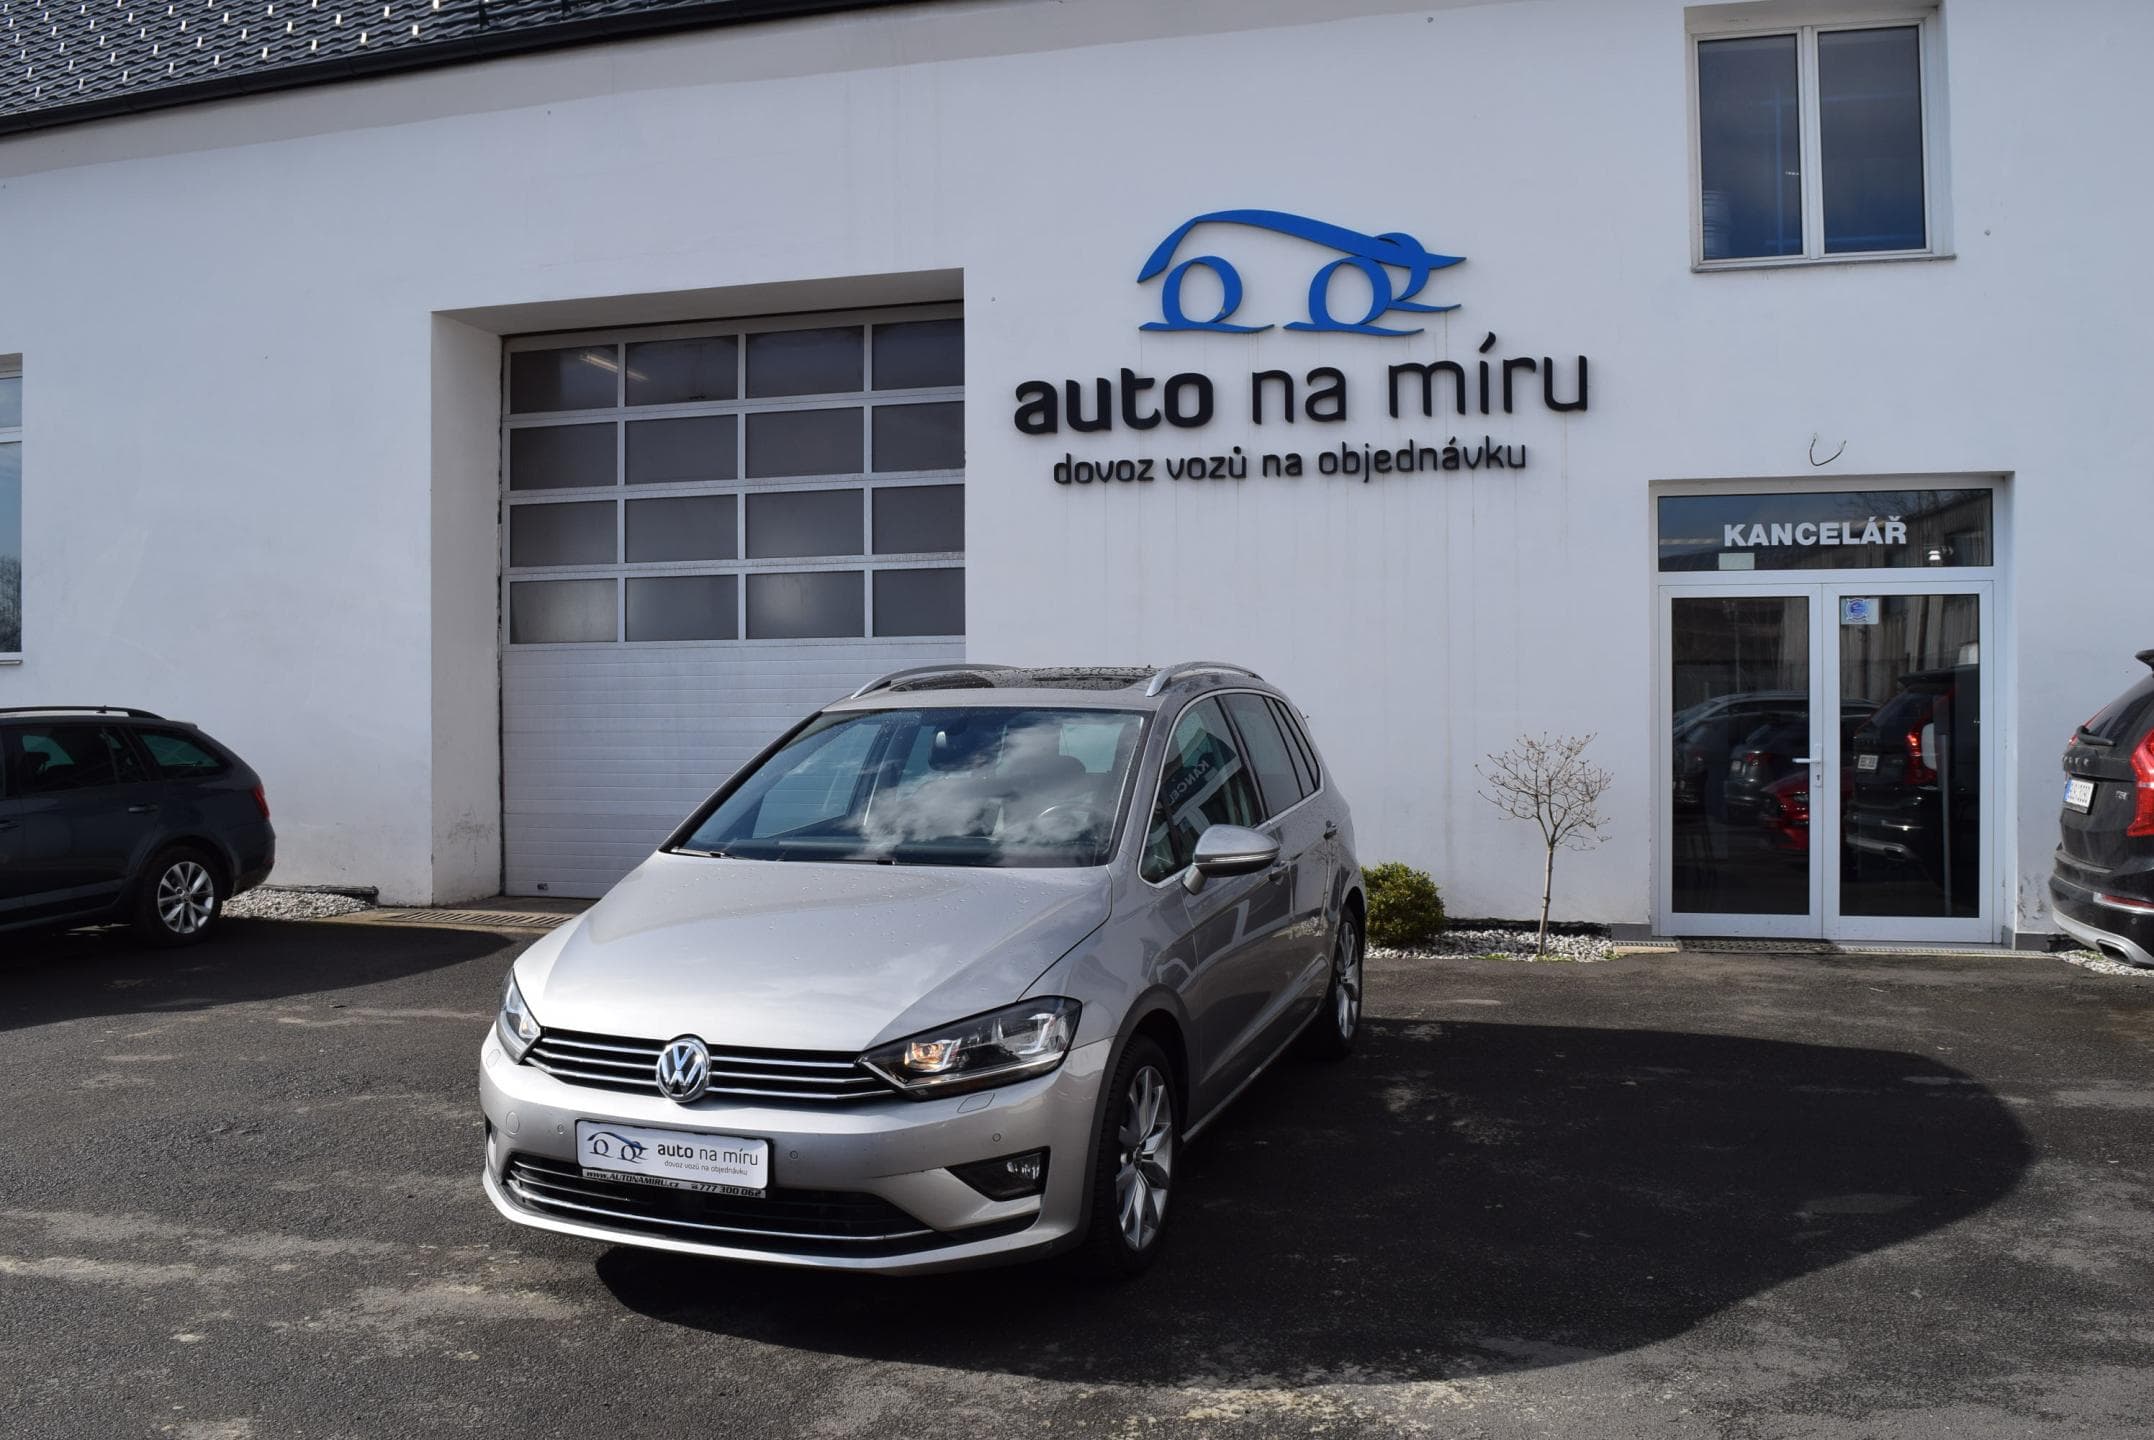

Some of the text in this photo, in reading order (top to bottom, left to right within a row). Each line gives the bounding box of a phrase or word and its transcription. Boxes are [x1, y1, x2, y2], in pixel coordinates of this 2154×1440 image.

[1014, 331, 1588, 435] auto na míru
[1053, 436, 1526, 485] dovoz vozů na objednávku
[1724, 515, 1907, 547] KANCELÁŘ
[657, 1143, 758, 1166] auto na míru
